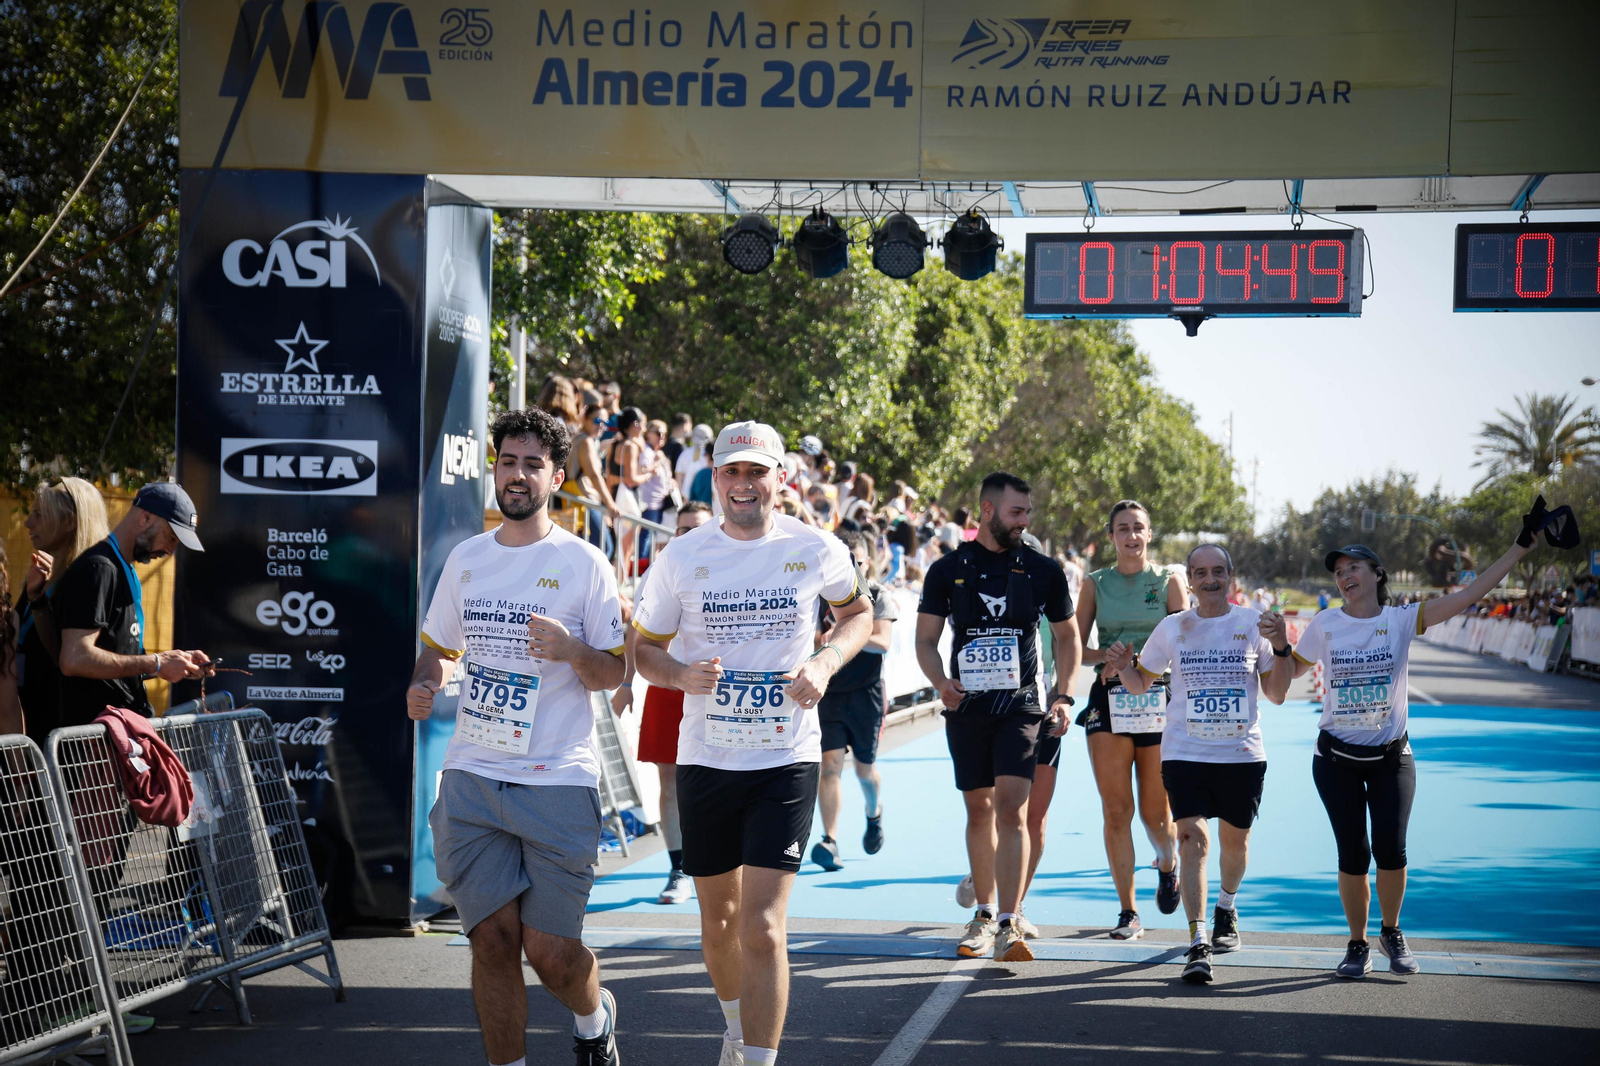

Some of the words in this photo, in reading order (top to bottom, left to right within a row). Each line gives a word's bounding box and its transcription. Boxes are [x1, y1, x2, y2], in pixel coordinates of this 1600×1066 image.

[440, 8, 493, 46] 25
[535, 9, 682, 47] Medio
[707, 10, 913, 49] Maratón
[1049, 18, 1133, 36] RFEA
[439, 48, 493, 61] EDICIÓN
[1041, 40, 1123, 54] SERIES
[1034, 56, 1084, 69] RUTA
[1090, 55, 1170, 69] RUNNING
[532, 57, 747, 107] Almería
[760, 60, 913, 108] 2024
[947, 79, 1071, 108] RAMÓN
[1087, 84, 1167, 107] RUIZ
[1182, 75, 1352, 107] ANDÚJAR
[222, 237, 347, 289] CASI
[438, 323, 455, 344] 2005
[220, 372, 382, 395] ESTRELLA
[257, 395, 281, 406] DE
[281, 396, 345, 407] LEVANTE
[730, 435, 766, 448] LALIGA
[242, 455, 360, 480] IKEA
[267, 528, 328, 543] Barceló
[267, 545, 306, 560] Cabo
[310, 545, 329, 560] de
[267, 561, 303, 576] Gata
[702, 590, 740, 600] Medio
[745, 586, 798, 598] Maratón
[463, 597, 492, 608] Medio
[497, 599, 547, 615] Maratón
[702, 599, 757, 613] Almería
[760, 597, 798, 611] 2024
[256, 591, 336, 636] ego
[463, 609, 506, 623] Almería
[508, 612, 534, 625] 202
[704, 615, 734, 623] RAMÓN
[759, 612, 798, 621] ANDÚJAR
[486, 626, 504, 634] RUIZ
[507, 628, 530, 637] ANDÚ
[966, 627, 1023, 636] CUPRA
[965, 646, 1013, 664] 5388
[1355, 645, 1390, 655] Maratón
[248, 653, 292, 669] SER
[1180, 656, 1218, 665] Almería
[1331, 656, 1364, 665] Almería
[1366, 652, 1393, 663] 2024
[248, 689, 262, 698] La
[263, 689, 284, 699] Voz
[284, 689, 298, 699] de
[299, 688, 342, 700] Almería
[470, 677, 528, 711] 5795
[715, 683, 784, 708] 5796
[1115, 692, 1161, 709] 5906
[1337, 685, 1388, 705] 5050
[478, 703, 485, 711] LA
[485, 706, 505, 715] GEMA
[1193, 697, 1240, 714] 5051
[252, 760, 336, 783] Analucía
